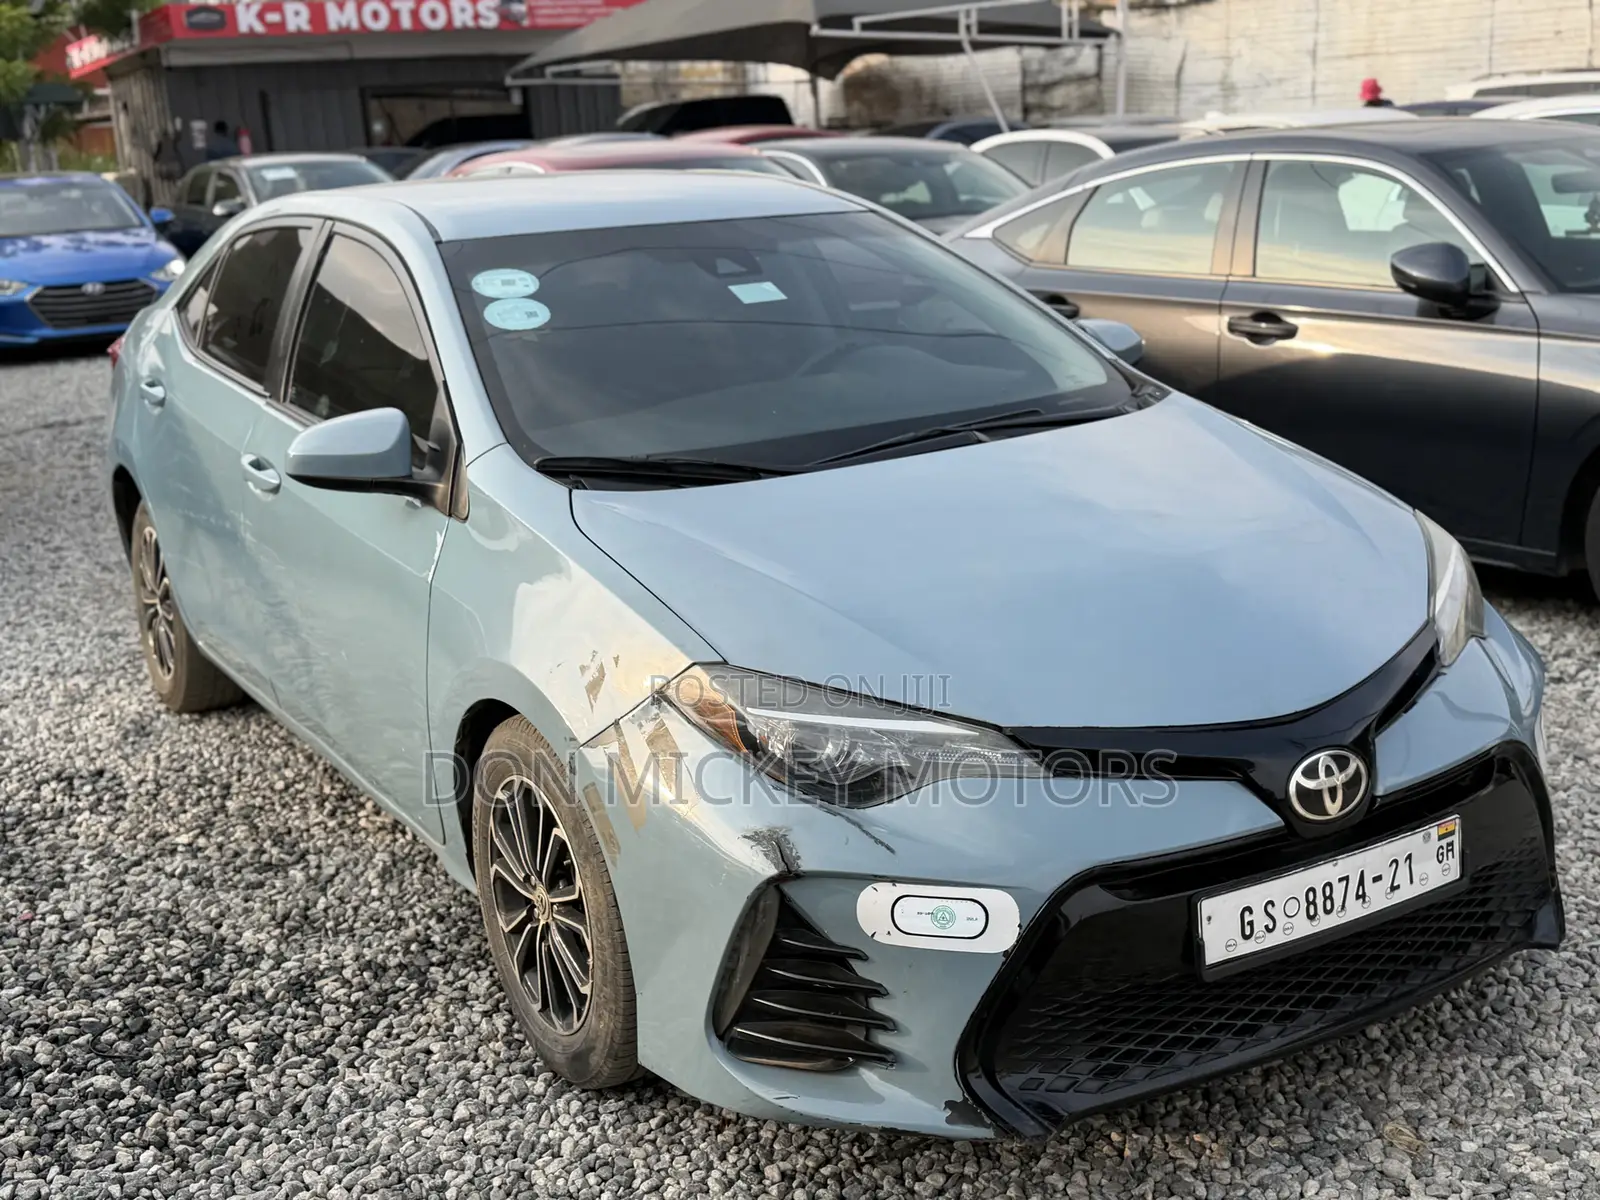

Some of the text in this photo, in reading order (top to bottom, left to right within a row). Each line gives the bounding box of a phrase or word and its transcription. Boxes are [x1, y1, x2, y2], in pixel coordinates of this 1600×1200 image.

[235, 2, 312, 34] K-R
[324, 0, 500, 31] MOTORS
[1239, 852, 1414, 940] GS 8874-21
